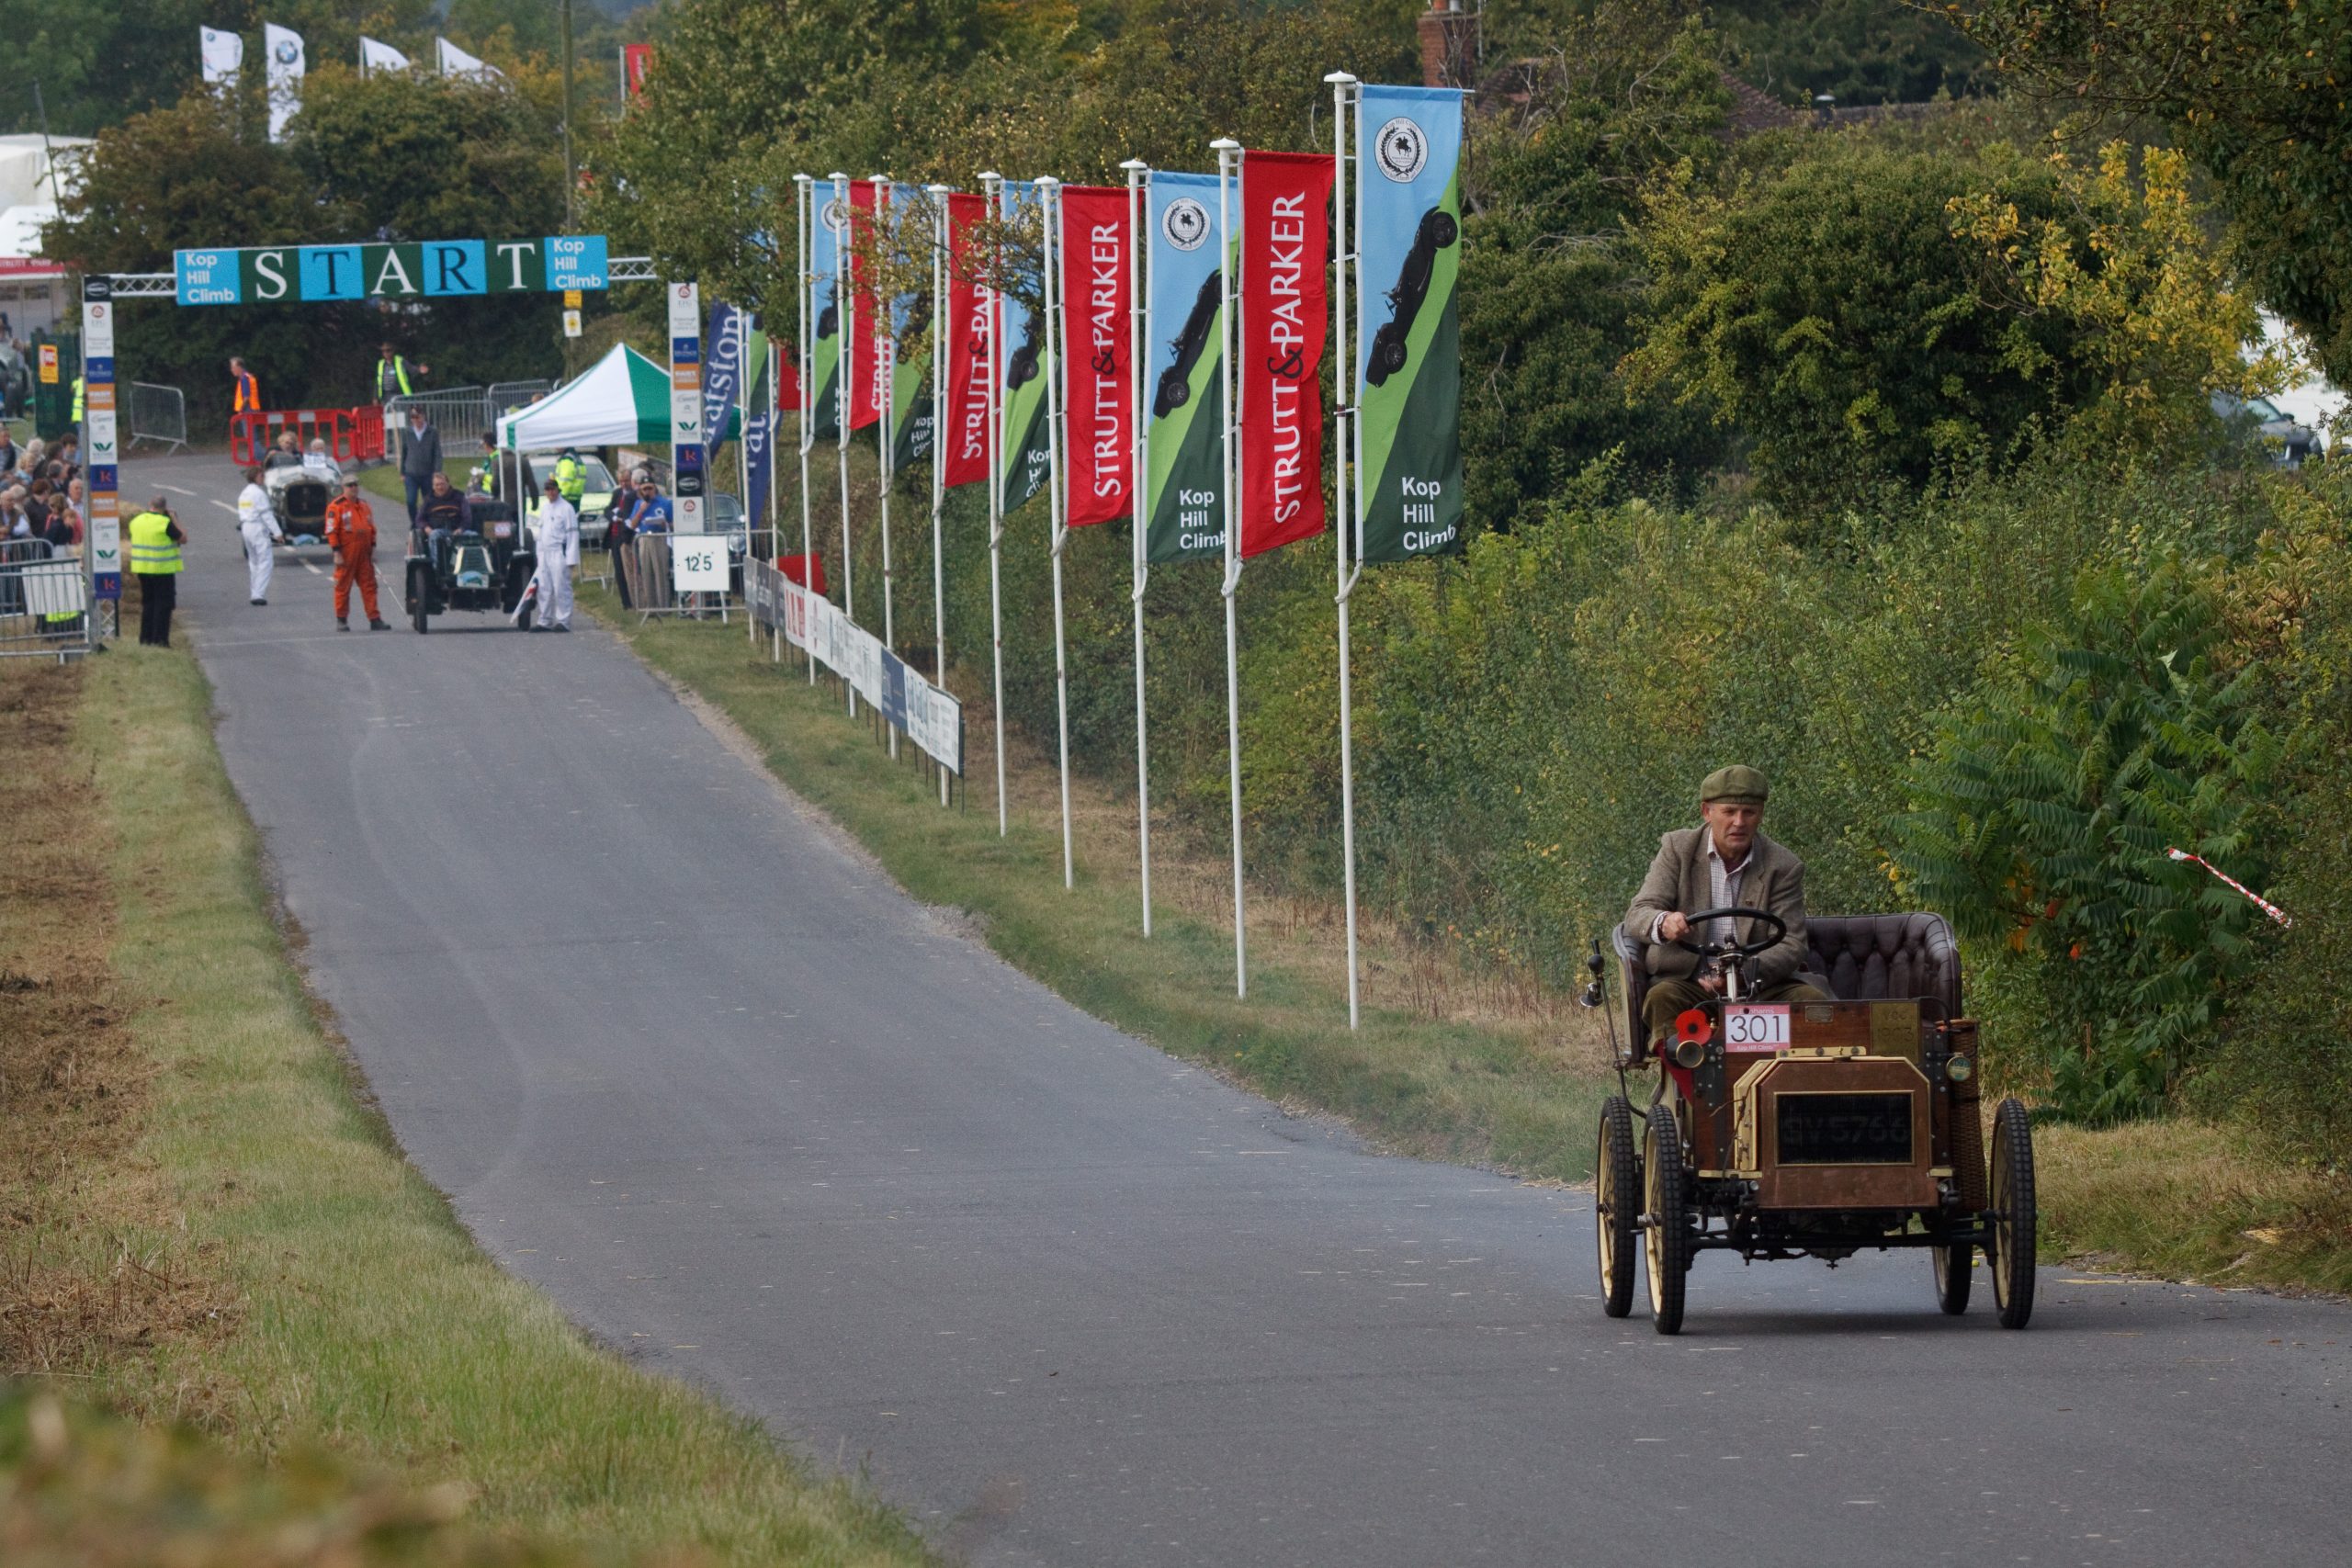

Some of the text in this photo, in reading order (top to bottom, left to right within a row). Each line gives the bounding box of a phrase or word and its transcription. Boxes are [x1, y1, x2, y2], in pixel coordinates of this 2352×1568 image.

[553, 239, 585, 254] Kop
[186, 253, 218, 269] Kop
[254, 243, 536, 299] START
[554, 257, 577, 271] Hill
[187, 270, 210, 285] Hill
[555, 274, 602, 288] Climb
[1271, 191, 1306, 355] PARKER
[187, 288, 235, 303] Climb
[1091, 220, 1119, 355] PARKER
[1094, 374, 1121, 497] STRUTT
[1272, 378, 1302, 524] STRUTT
[1179, 489, 1215, 507] Kop
[1402, 477, 1441, 501] Kop
[1180, 510, 1208, 528] Hill
[1403, 504, 1435, 524] Hill
[1403, 524, 1456, 551] Climb
[1731, 1015, 1780, 1043] 301
